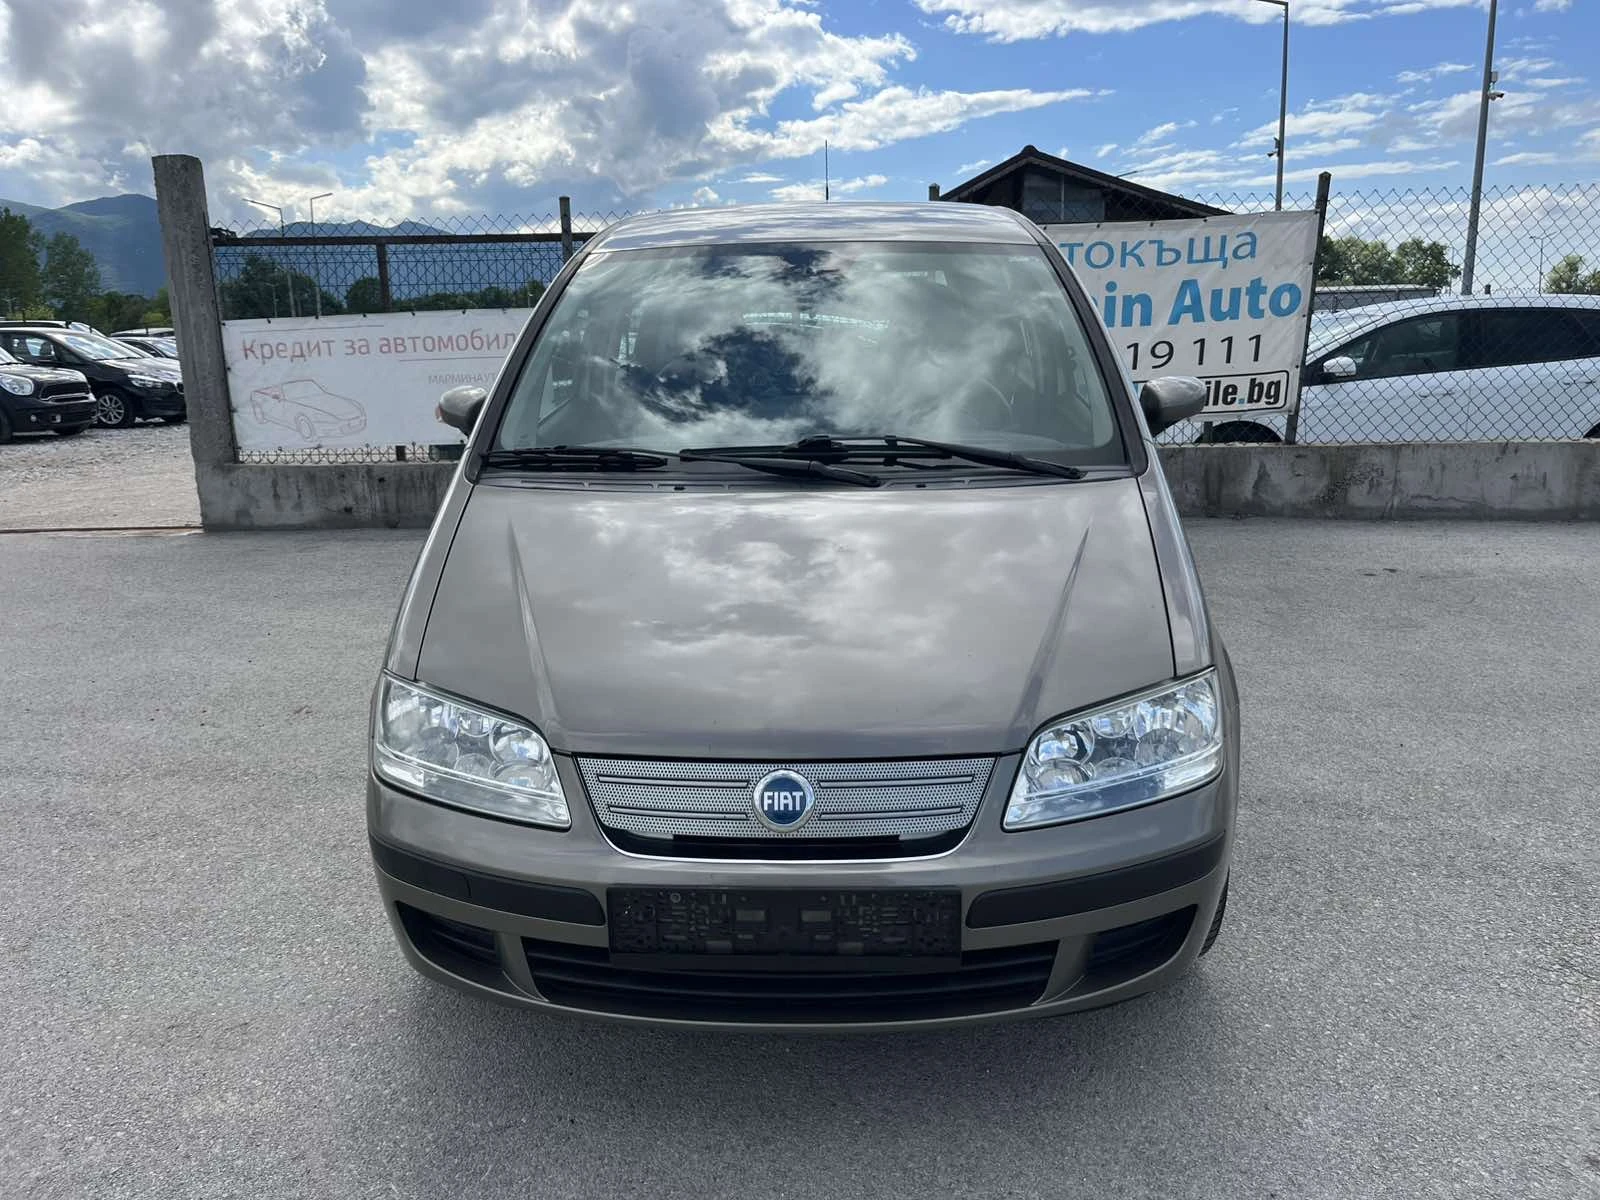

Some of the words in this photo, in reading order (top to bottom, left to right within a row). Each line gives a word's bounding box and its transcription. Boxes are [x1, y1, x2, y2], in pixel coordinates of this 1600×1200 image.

[1091, 280, 1152, 328] in
[1167, 276, 1302, 326] Auto
[242, 338, 336, 365] Кредит
[344, 337, 371, 356] за
[1126, 340, 1175, 371] 19
[1193, 334, 1262, 366] 111
[763, 791, 804, 811] FIAT
